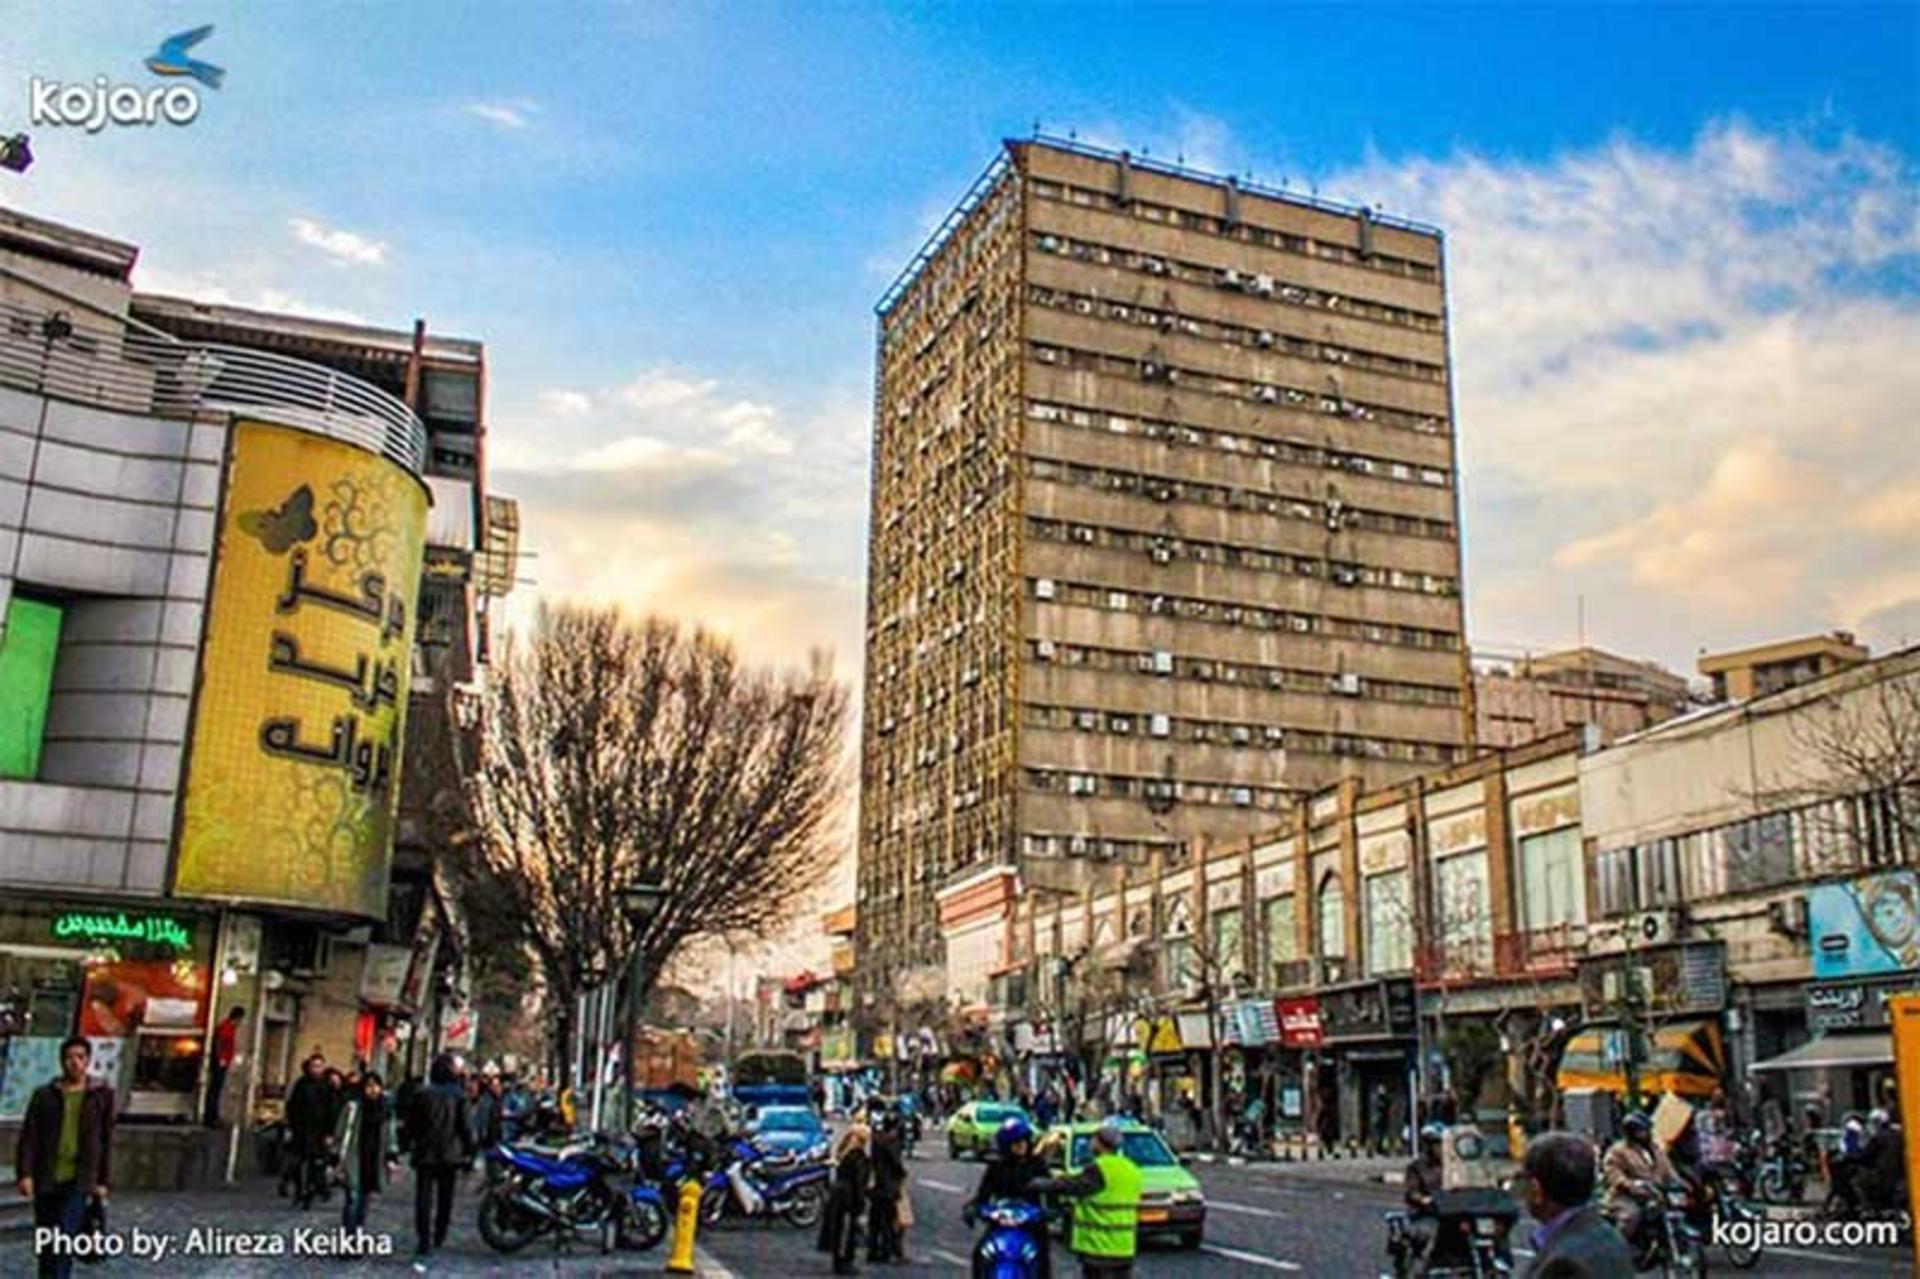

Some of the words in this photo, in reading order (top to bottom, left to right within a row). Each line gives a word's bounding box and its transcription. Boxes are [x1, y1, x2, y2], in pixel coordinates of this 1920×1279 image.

[276, 546, 405, 643] مرکز
[269, 632, 398, 713] خرید
[259, 713, 393, 796] پروانه
[55, 912, 144, 938] مخصوص
[146, 916, 191, 949] پیتزا
